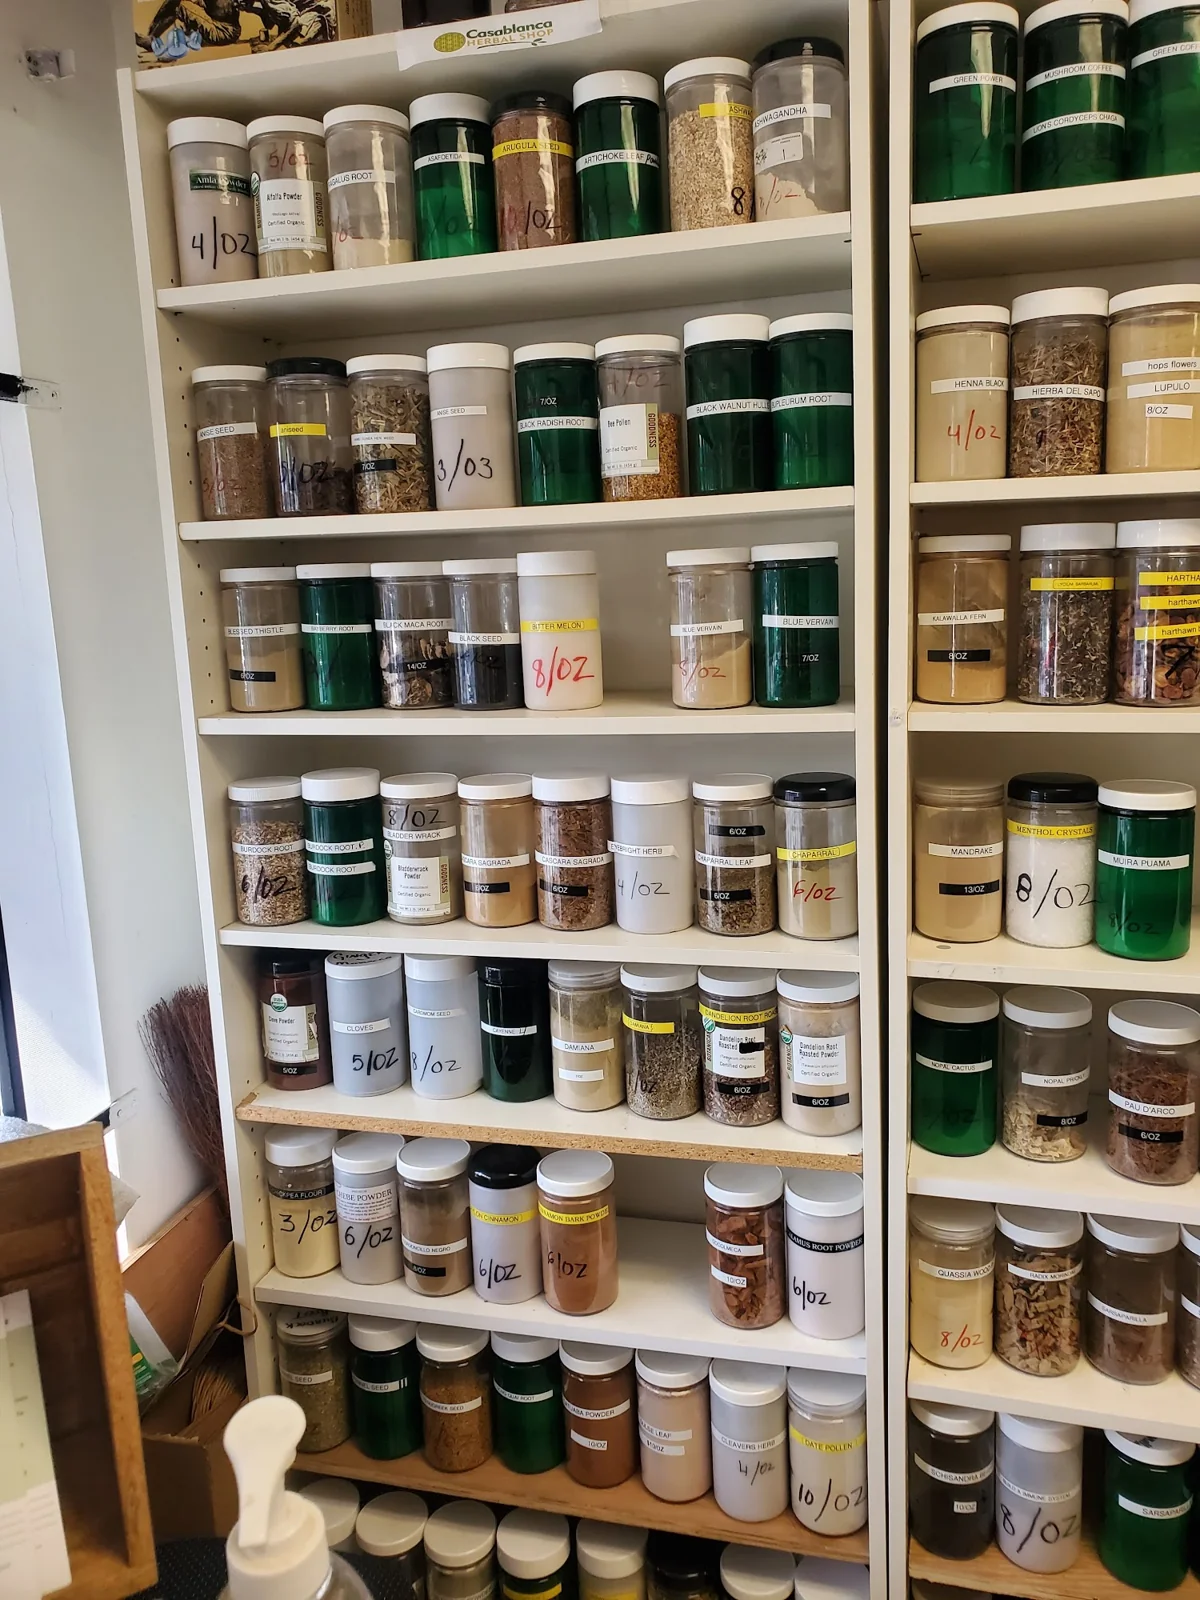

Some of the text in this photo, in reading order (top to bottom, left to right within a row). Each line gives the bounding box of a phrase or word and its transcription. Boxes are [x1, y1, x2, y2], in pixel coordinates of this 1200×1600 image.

[466, 20, 553, 39] Casablanca
[466, 29, 554, 47] HERBAL SHOP
[1152, 44, 1179, 58] GREEN
[1044, 63, 1113, 80] MUSHROOM COFFEE
[953, 74, 1003, 84] GREEN POWER
[754, 105, 808, 129] ASHWAGANDHA
[1053, 113, 1098, 127] CORDYCEPS
[1099, 113, 1118, 122] CHAGA
[502, 141, 561, 153] ARUGULA SEED
[584, 152, 645, 165] ARTICHOKE LEAF
[196, 175, 217, 185] Amla
[351, 172, 373, 181] ROOT
[283, 192, 303, 201] Powder
[314, 191, 325, 228] GOODNESS
[1147, 360, 1198, 371] hops flowers
[954, 379, 1005, 389] HENNA BLACK
[1154, 382, 1191, 393] LUPULO
[1032, 386, 1101, 398] HIERBA DEL SAPO
[539, 397, 558, 406] 7/OZ
[808, 394, 833, 403] ROOT
[450, 407, 466, 415] SEED
[696, 401, 751, 414] BLACK WALNUT
[1146, 406, 1169, 415] 8/OZ
[519, 417, 586, 430] BLACK RADISH ROOT
[616, 418, 631, 427] Pollen
[215, 426, 235, 436] SEED
[647, 412, 657, 448] GOODNESS
[782, 618, 804, 627] BLUE
[932, 614, 968, 622] KALAWALLA
[383, 620, 445, 629] BLACK MACA ROOT
[532, 621, 583, 631] BITTER MELON
[696, 624, 723, 633] VERVAIN
[254, 626, 285, 635] THISTLE
[1161, 626, 1197, 636] harthawn
[801, 654, 820, 663] 7/OZ
[406, 662, 428, 671] 14/OZ
[387, 830, 442, 840] BLADDER WRACK
[728, 827, 747, 836] 6/OZ
[1016, 825, 1094, 836] MENTHOL CRYSTALS
[240, 843, 294, 853] BURDOCK ROOT
[306, 842, 335, 852] BURDOCK
[610, 843, 641, 855] EYEBRIGHT
[950, 846, 993, 856] MANDRAKE
[791, 849, 837, 859] CHAPARRAL
[477, 857, 512, 867] SAGRADA
[541, 856, 605, 866] CASCARA SAGRADA
[697, 853, 754, 867] CHAPARRAL LEAF
[1112, 856, 1172, 868] MUIRA PUAMA
[308, 864, 358, 874] BURDOCK ROOT
[397, 864, 429, 872] Bladderwrack
[404, 872, 422, 880] Powder
[440, 863, 449, 894] GOODNESS
[964, 885, 985, 894] 13/OZ
[713, 891, 730, 900] 6/OZ
[279, 1016, 296, 1025] Powder
[705, 1009, 763, 1023] DANDELION ROOT
[346, 1024, 374, 1032] CLOVES
[719, 1033, 744, 1044] Dandelion
[564, 1043, 595, 1051] DAMIANA
[718, 1042, 738, 1051] Roasted
[799, 1041, 838, 1051] Dandelion Root
[799, 1049, 820, 1058] Roasted
[282, 1067, 298, 1075] 5/OZ
[931, 1061, 950, 1071] NOPAL
[1043, 1077, 1065, 1085] NOPAL
[733, 1086, 751, 1094] 6/OZ
[811, 1098, 830, 1106] 6/OZ
[1124, 1100, 1176, 1115] PAU D'ARCO
[1060, 1117, 1077, 1126] 8/OZ
[1140, 1131, 1161, 1141] 6/OZ
[301, 1189, 323, 1199] FLOUR
[357, 1189, 393, 1201] POWDER
[483, 1214, 520, 1223] CINNAMON
[812, 1237, 864, 1252] ROOT POWDER
[937, 1269, 972, 1279] QUASSIA
[1029, 1272, 1049, 1280] RADIX
[726, 1276, 746, 1286] 10/OZ
[371, 1383, 389, 1391] SEED
[585, 1409, 615, 1418] POWDER
[655, 1430, 672, 1439] LEAF
[588, 1440, 606, 1449] 10/OZ
[721, 1436, 776, 1450] CLEAVERS HERB
[804, 1441, 853, 1452] DATE POLLEN
[930, 1467, 979, 1483] SCHISANDRA
[955, 1503, 976, 1511] 10/OZ
